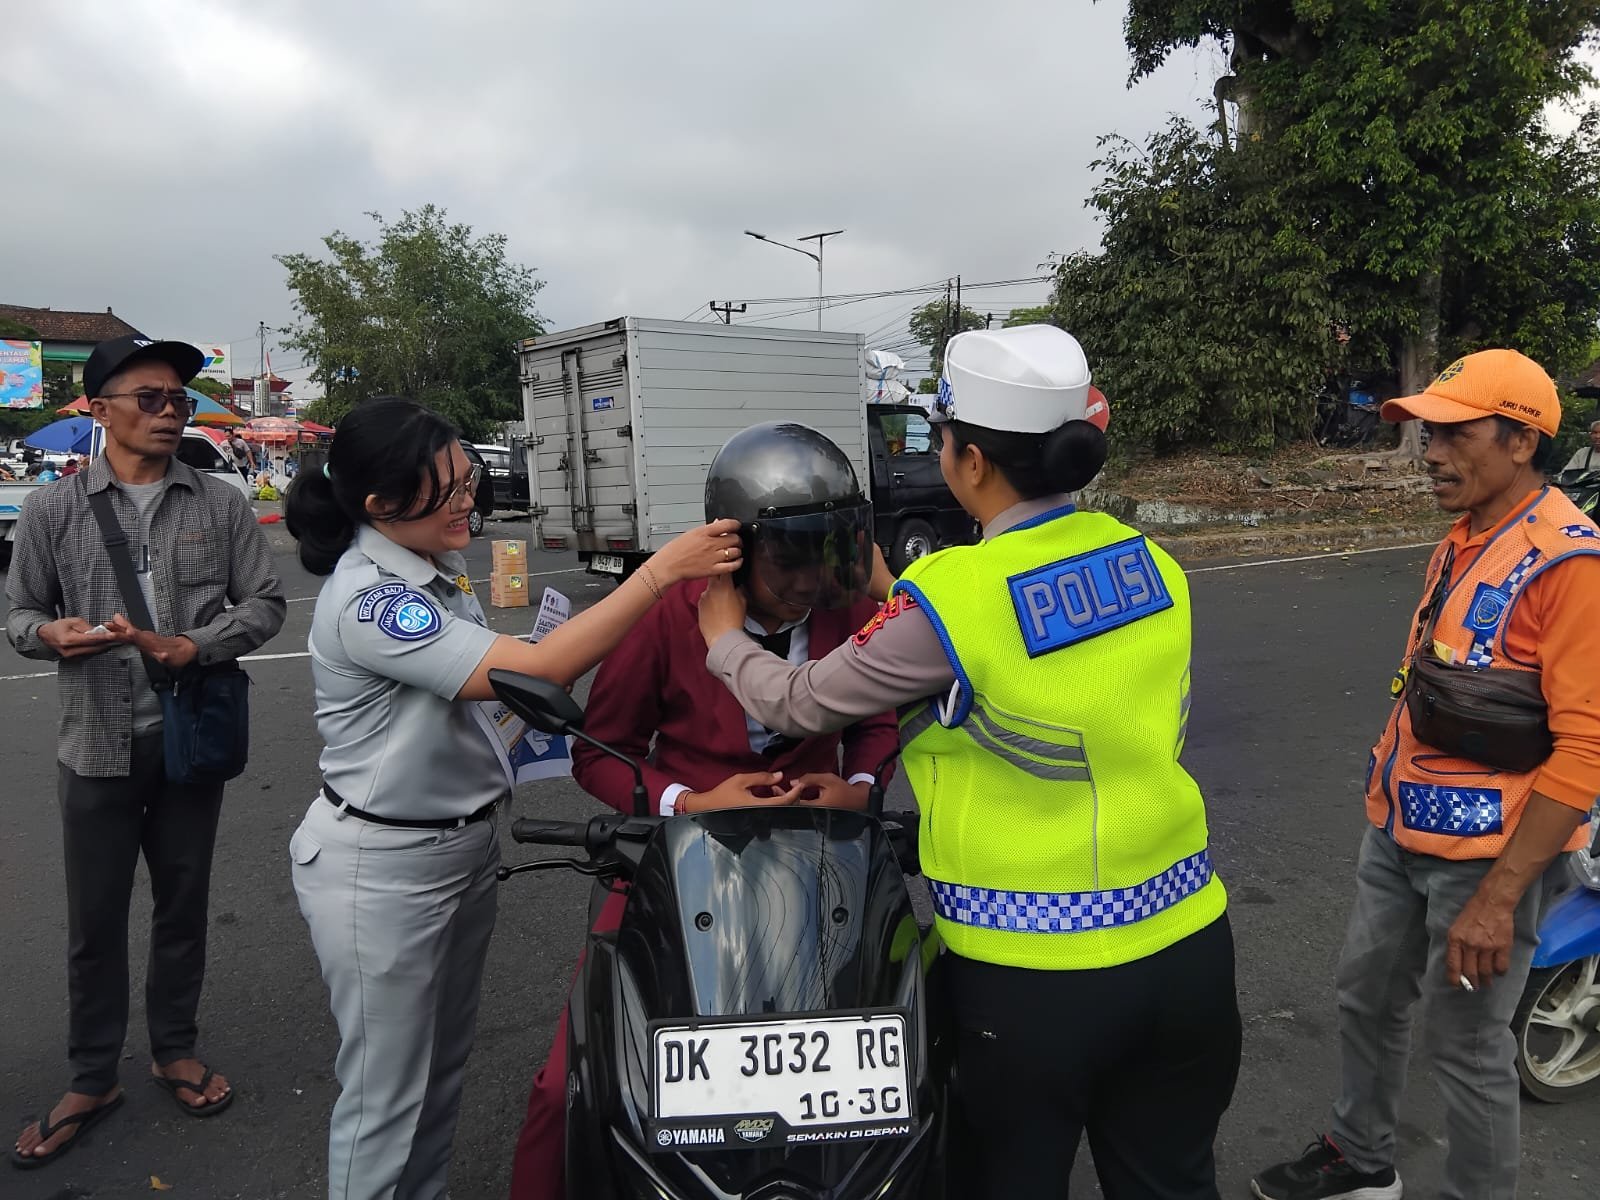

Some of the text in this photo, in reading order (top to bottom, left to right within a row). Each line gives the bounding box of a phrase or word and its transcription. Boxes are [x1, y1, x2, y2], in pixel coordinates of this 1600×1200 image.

[1021, 548, 1163, 640] POLISI
[384, 612, 396, 628] JASA
[664, 1026, 900, 1083] DK 3032 RG
[672, 1128, 725, 1145] YAMAHA
[786, 1125, 909, 1142] SEMAKIN DI DEPAN
